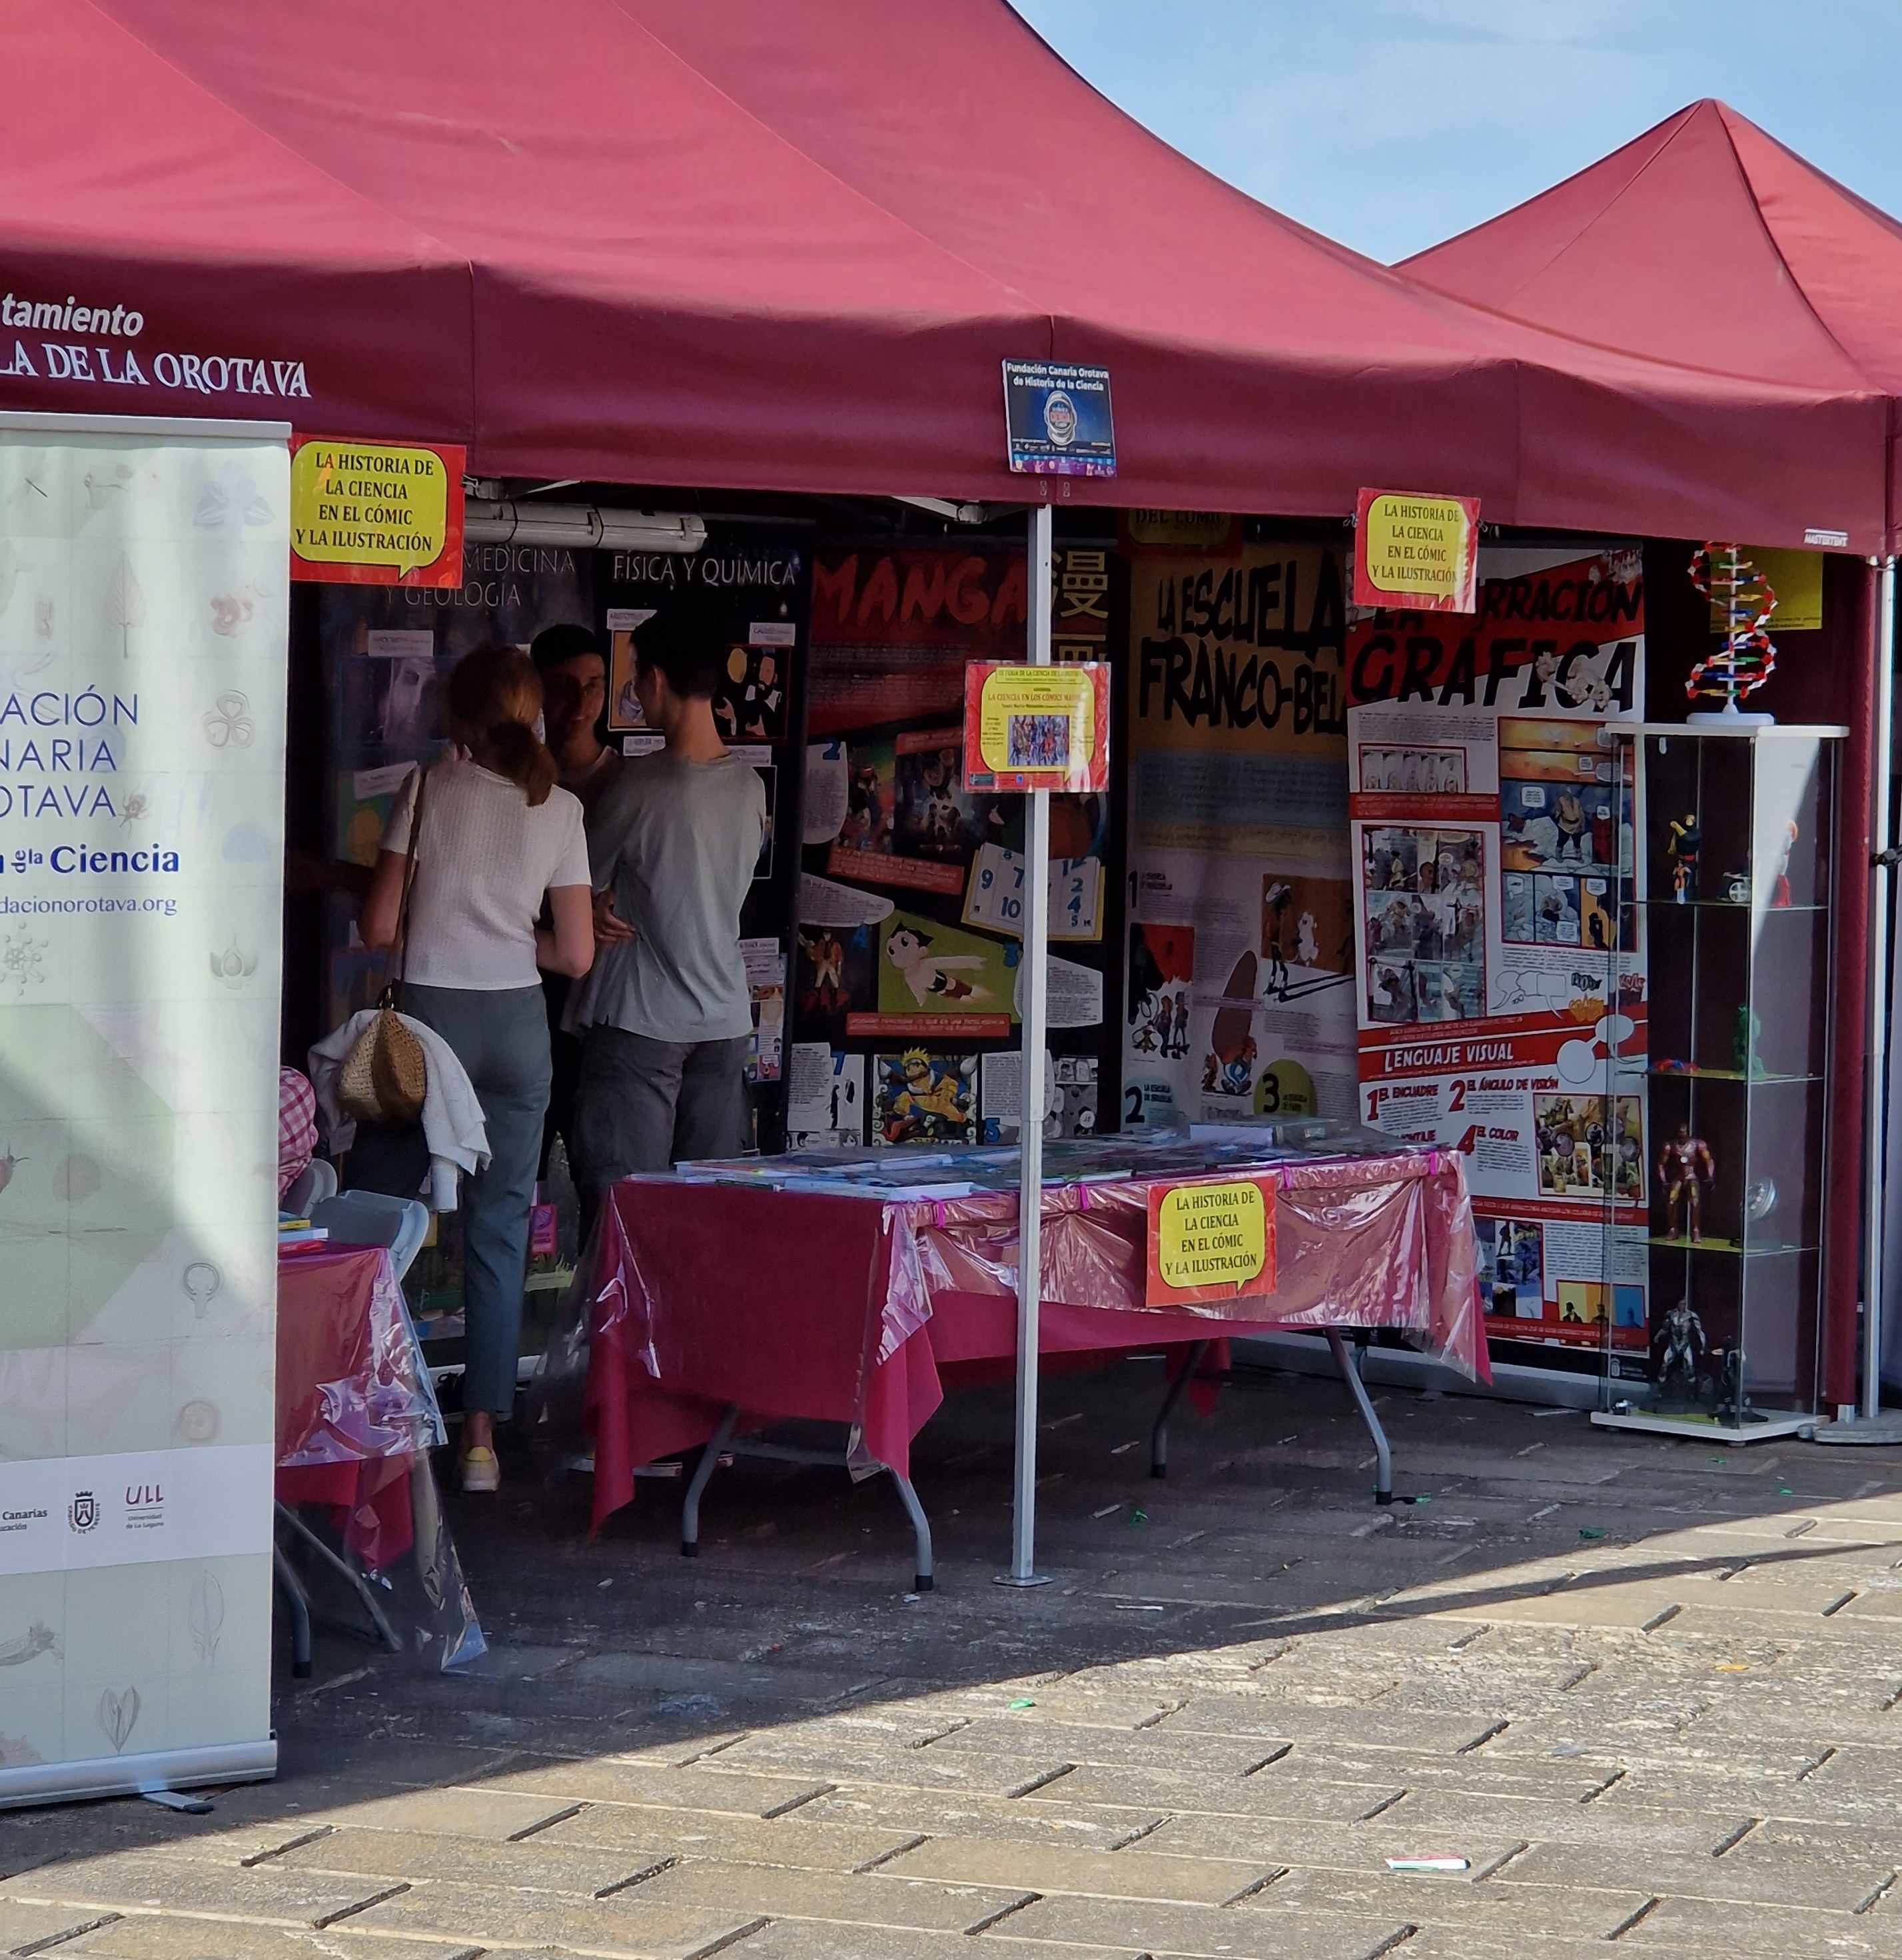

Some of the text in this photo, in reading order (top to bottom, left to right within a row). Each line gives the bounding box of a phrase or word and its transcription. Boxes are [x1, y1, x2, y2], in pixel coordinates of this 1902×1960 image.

[1, 292, 144, 337] tamiento
[41, 343, 95, 381] DE
[96, 348, 151, 386] LA
[153, 352, 312, 398] OROTAVA
[1007, 362, 1109, 379] Fundación Canaria Orotava
[1013, 376, 1104, 392] de Historia de la Ciencia
[316, 452, 434, 476] LA HISTORIA DE
[326, 480, 408, 500] LA CIENCIA
[319, 504, 413, 525] EN EL CÓMIC
[1384, 504, 1460, 522] LA HISTORIA DE
[296, 529, 432, 552] Y LA ILUSTRACIÓN
[1392, 525, 1444, 541] LA CIENCIA
[1388, 545, 1446, 562] EN EL CÓMIC
[612, 549, 796, 586] FÍSICA Y QUÍMICA
[1372, 565, 1458, 582] Y LA ILUSTRACIÓN
[811, 553, 1027, 628] MANGA
[1181, 549, 1346, 666] ESCUELA
[0, 684, 138, 726] ACIÓN
[29, 848, 43, 865] la
[50, 843, 180, 873] Ciencia
[981, 869, 993, 890] 9
[1013, 867, 1024, 889] 7
[1071, 877, 1083, 893] 2
[1001, 896, 1021, 918] 10
[1067, 895, 1081, 913] 4
[1384, 1045, 1461, 1073] LENGUAJE
[1466, 1043, 1514, 1063] VISUAL
[1262, 1073, 1280, 1113] 3
[1448, 1079, 1466, 1113] 2
[1125, 1086, 1145, 1124] 2
[1367, 1089, 1381, 1121] 1
[984, 1118, 1001, 1143] 5
[1456, 1124, 1480, 1155] 4
[1177, 1191, 1254, 1211] LA HISTORIA DE
[1185, 1213, 1239, 1231] LA CIENCIA
[1181, 1232, 1243, 1252] EN EL CÓMIC
[1165, 1251, 1257, 1275] Y LA ILUSTRACIÓN
[126, 1484, 164, 1504] ULL
[3, 1508, 48, 1520] Canarias
